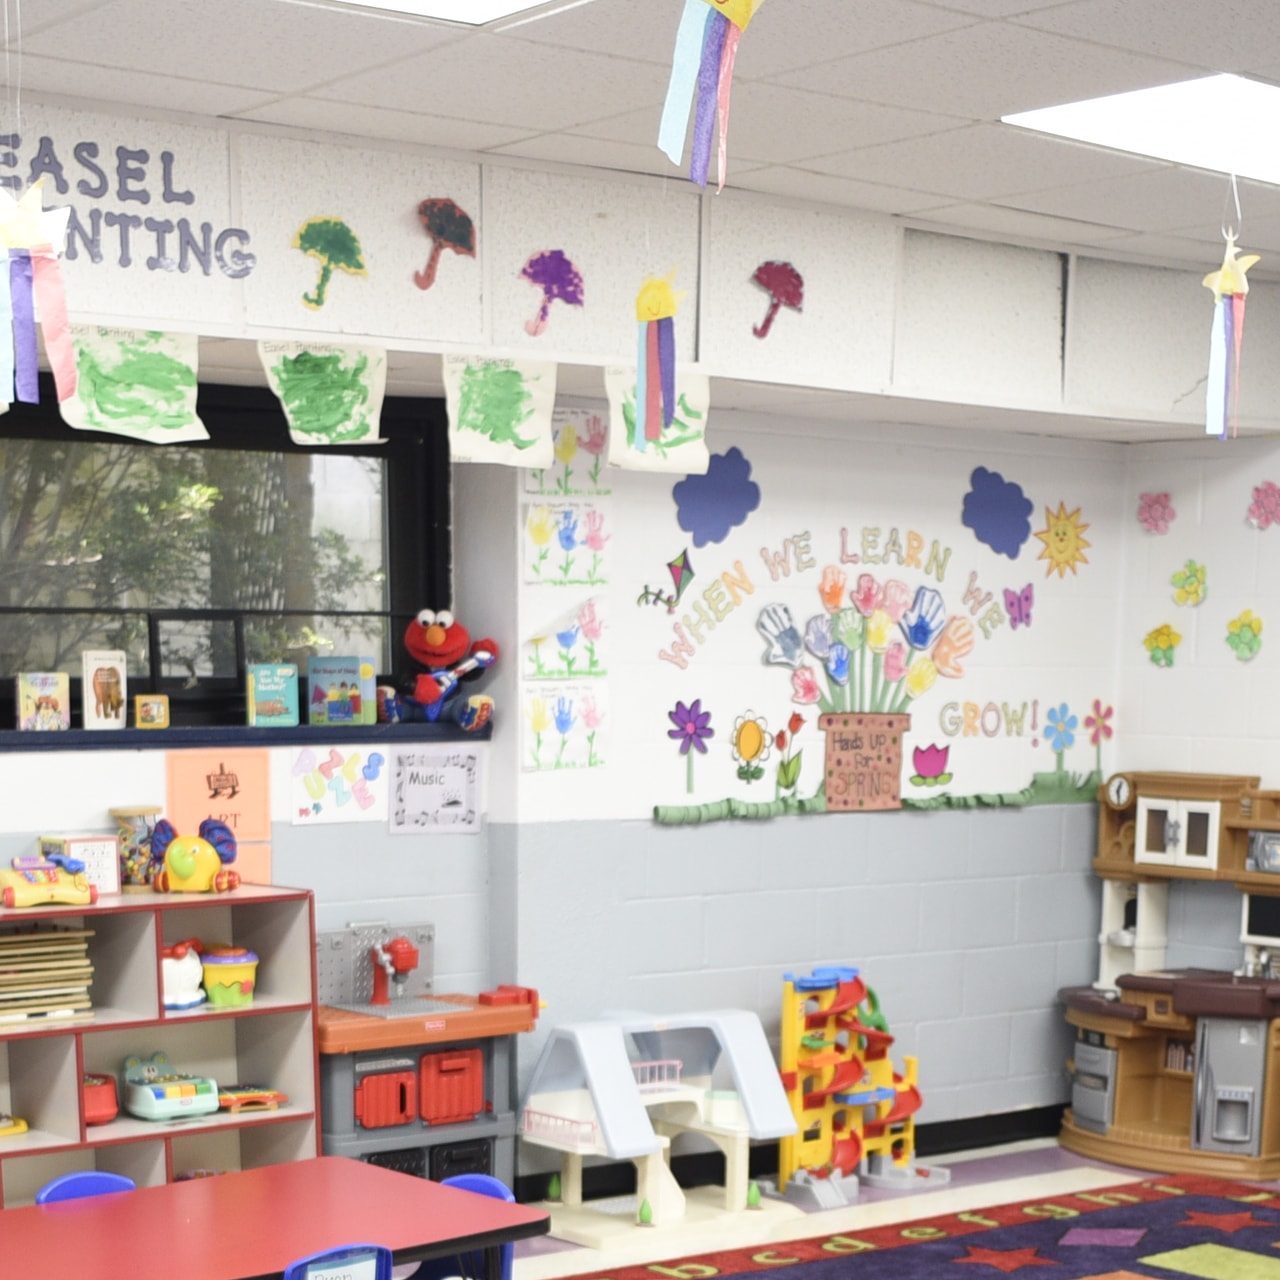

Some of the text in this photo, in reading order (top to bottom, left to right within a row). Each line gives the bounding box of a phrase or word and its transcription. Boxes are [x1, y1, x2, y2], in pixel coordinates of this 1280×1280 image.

[659, 527, 1006, 670] WHEN WE LEARN WE
[939, 699, 1039, 747] GROW!
[832, 732, 864, 752] Hands
[408, 771, 446, 786] Music
[835, 771, 892, 797] SPRING
[646, 1262, 720, 1280] b
[752, 1251, 801, 1264] c
[821, 1235, 876, 1253] d
